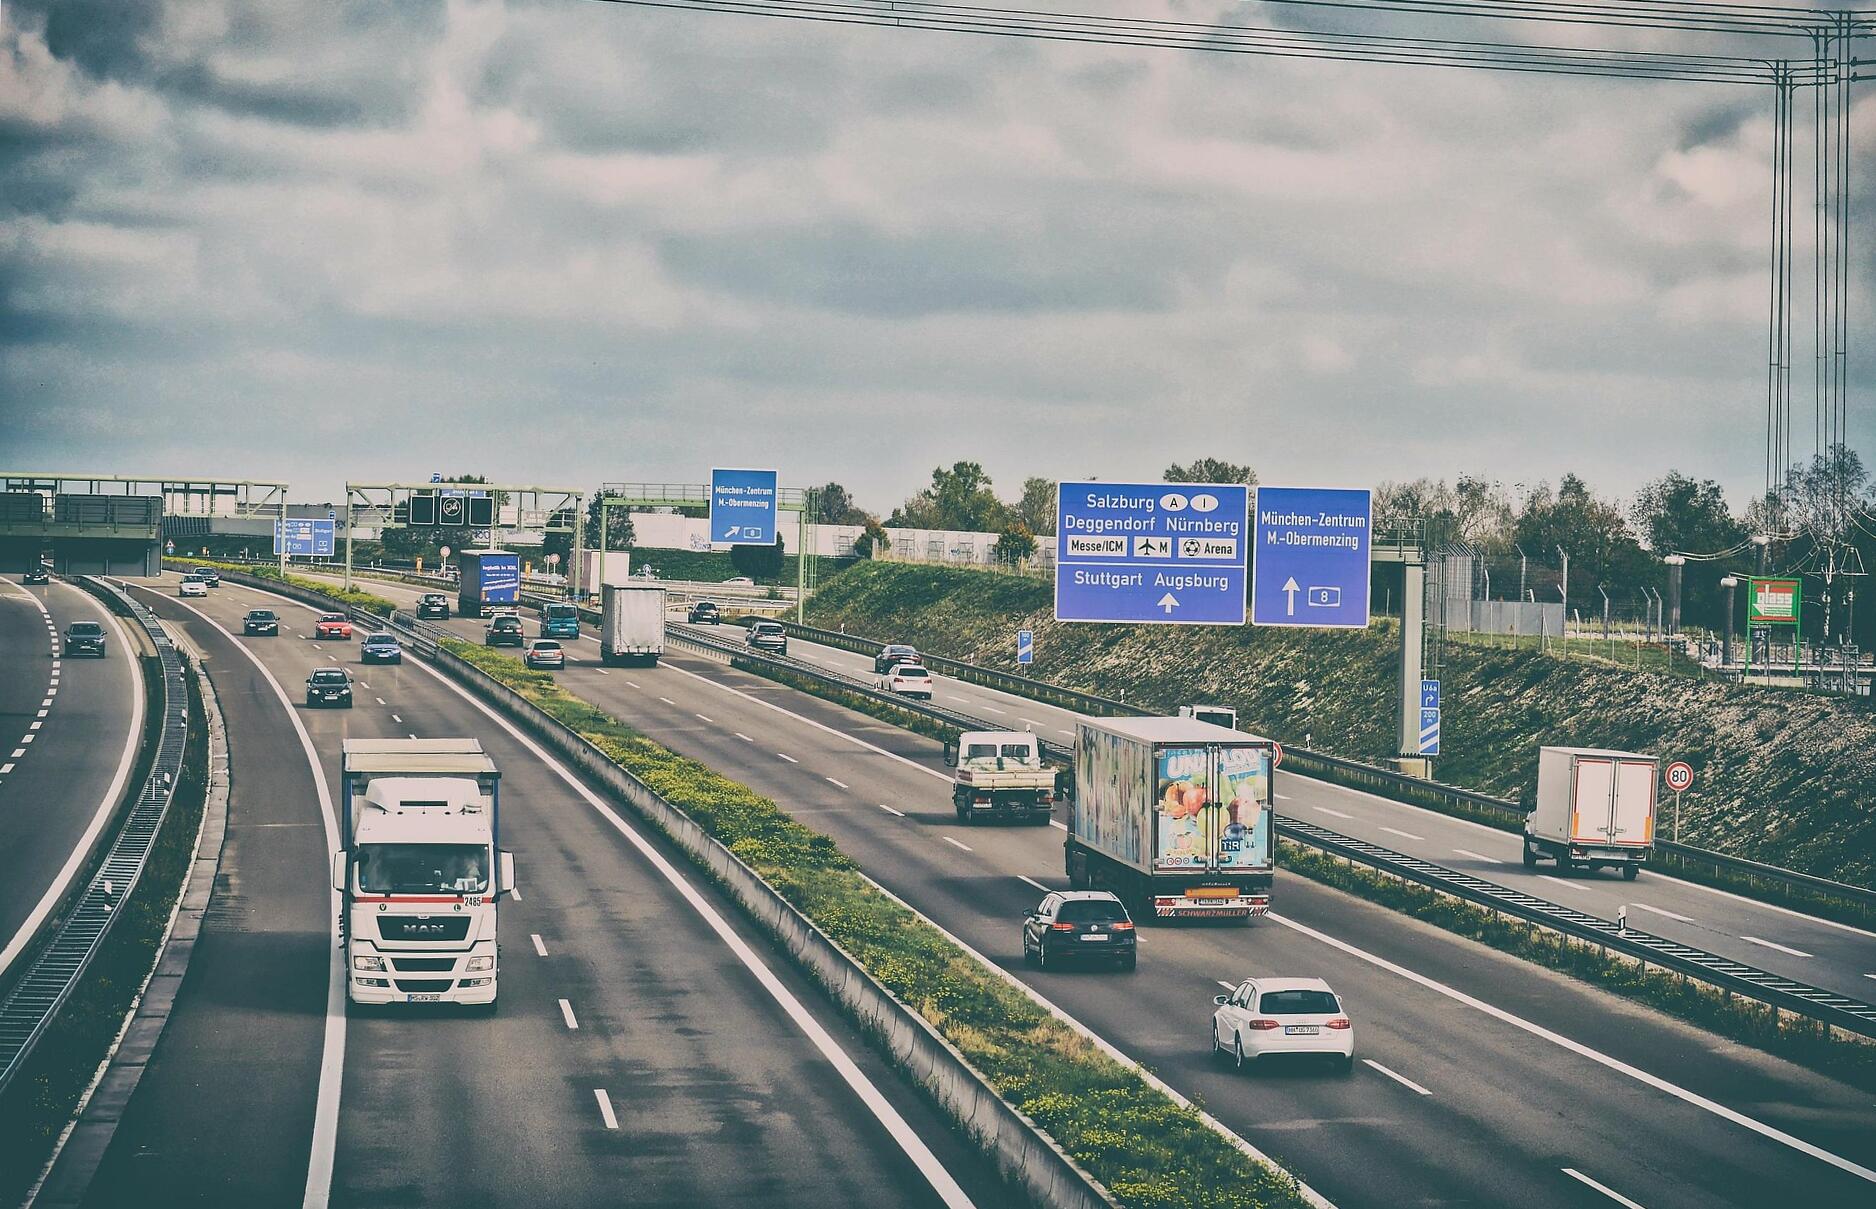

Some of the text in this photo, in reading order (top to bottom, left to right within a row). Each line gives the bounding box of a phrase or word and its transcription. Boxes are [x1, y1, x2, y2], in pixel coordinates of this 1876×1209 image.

[715, 485, 773, 495] München-Zentrum
[718, 497, 769, 510] M.-Obermenzing
[1087, 493, 1155, 513] Salzburg
[1169, 498, 1178, 508] A
[1065, 514, 1239, 536] Deggendorf Nürnberg
[1261, 510, 1366, 528] München-Zentrum
[1071, 539, 1233, 555] Messe/ICM M Arena
[1267, 530, 1359, 551] M.-Obermenzing
[1074, 570, 1229, 591] Stuttgart Augsburg
[1320, 590, 1329, 603] 8
[1671, 770, 1687, 783] 80
[1221, 840, 1240, 850] TIR
[464, 896, 481, 907] 2485
[1177, 909, 1247, 917] SCHWARZMÜLLER
[403, 925, 445, 933] MAN
